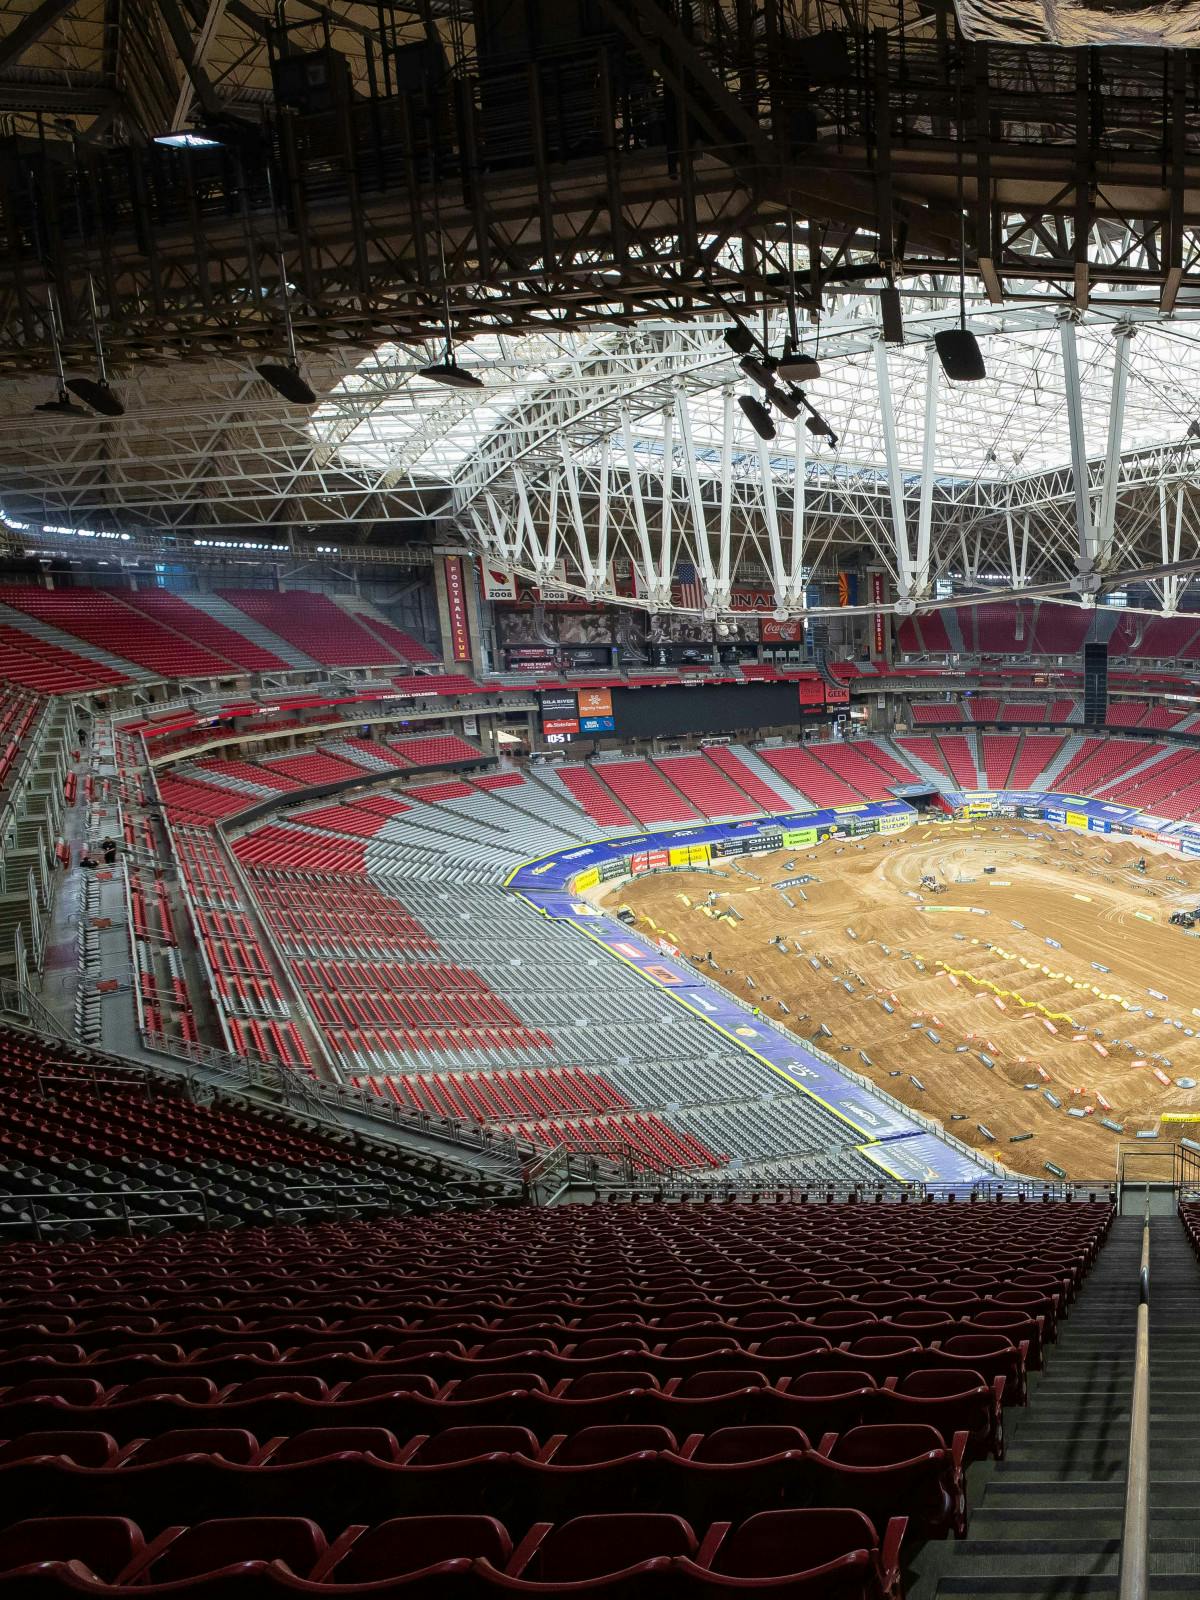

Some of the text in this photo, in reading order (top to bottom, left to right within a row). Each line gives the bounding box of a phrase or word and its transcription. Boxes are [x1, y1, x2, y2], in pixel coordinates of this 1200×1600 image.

[450, 566, 466, 658] FOOTBALL CLUB
[489, 591, 513, 599] 2008
